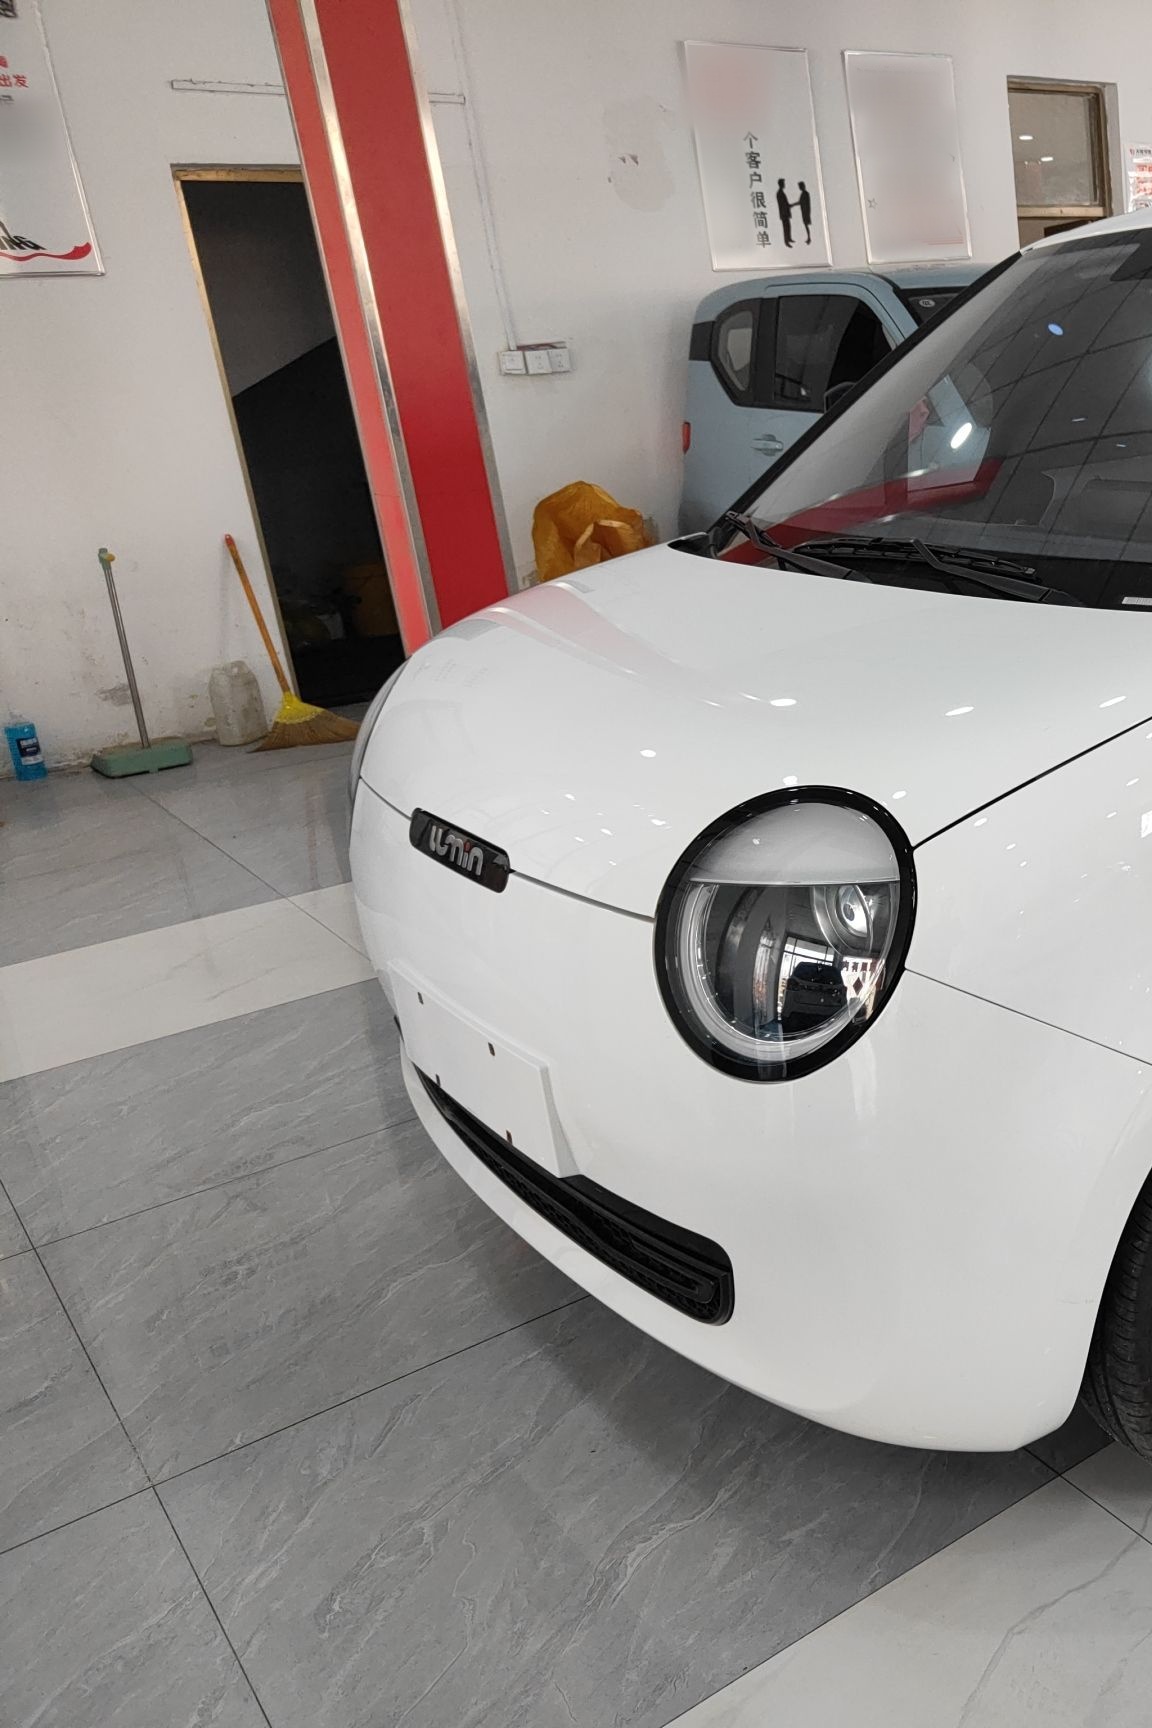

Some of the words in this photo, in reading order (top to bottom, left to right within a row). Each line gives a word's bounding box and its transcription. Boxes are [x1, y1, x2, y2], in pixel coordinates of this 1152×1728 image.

[743, 131, 771, 248] 个客户很简单
